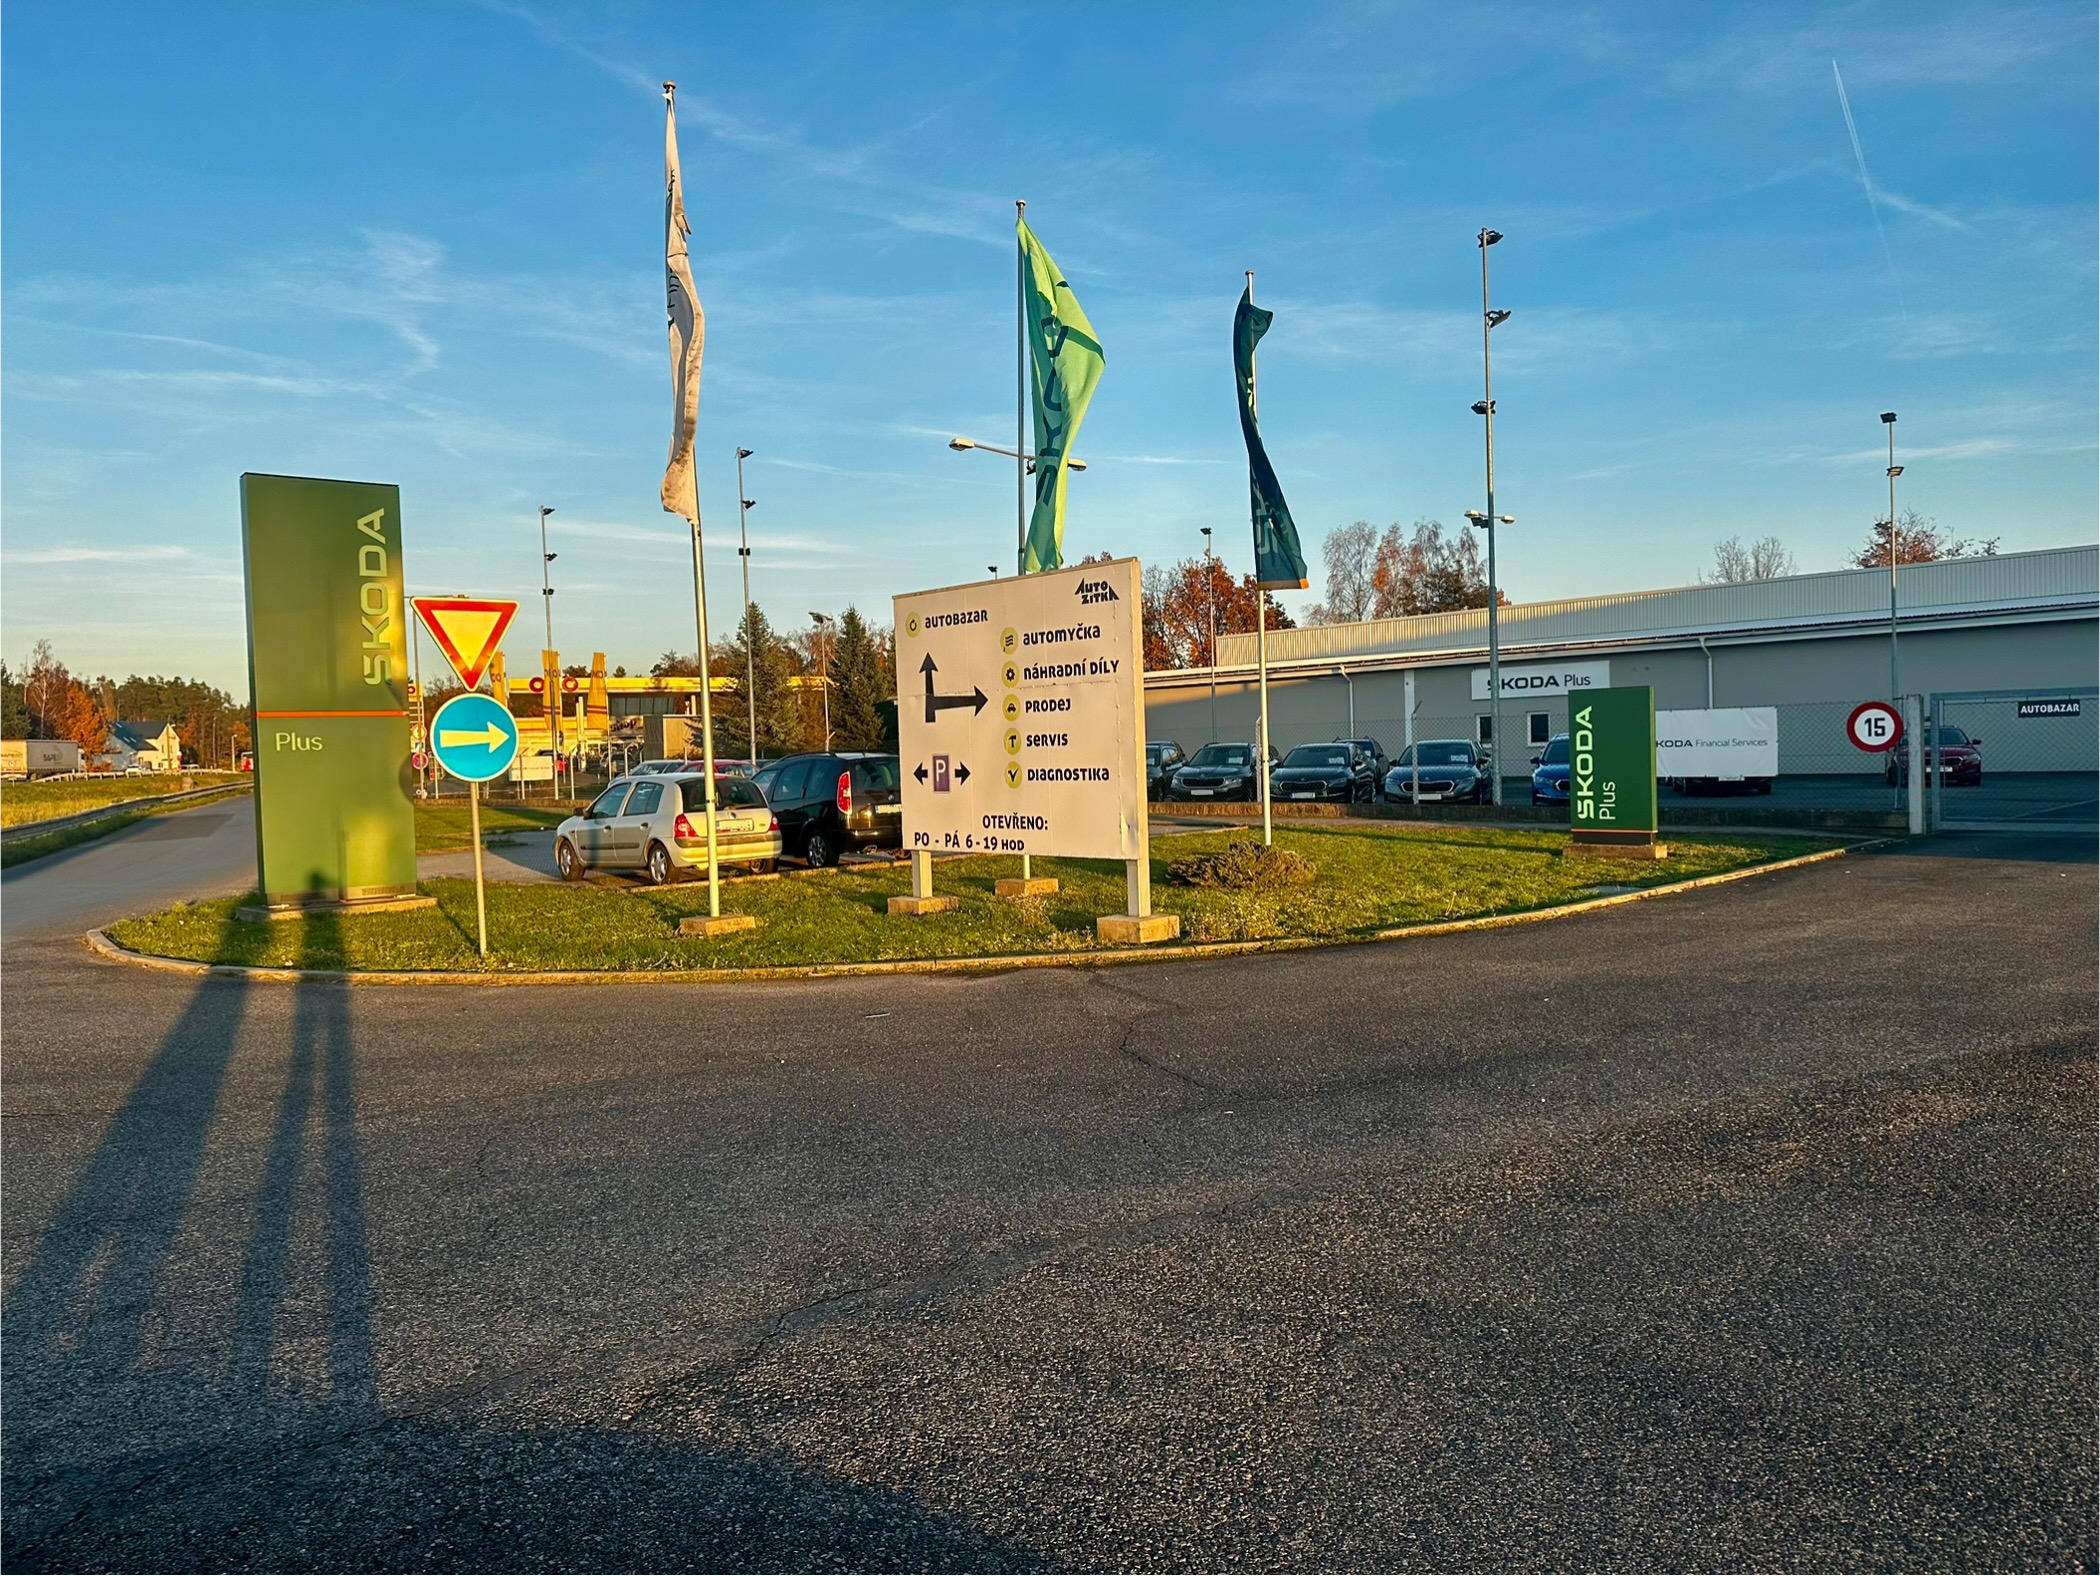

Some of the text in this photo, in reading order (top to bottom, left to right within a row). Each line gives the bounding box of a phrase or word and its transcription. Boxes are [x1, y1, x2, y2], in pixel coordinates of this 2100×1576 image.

[1074, 577, 1109, 595] AUTO
[1564, 674, 1591, 686] Plus
[2020, 702, 2080, 715] AUTOBAZAR
[1864, 717, 1886, 737] 15
[275, 732, 323, 752] Plus
[1655, 738, 1768, 748] KODA Financial Services
[935, 758, 946, 781] P
[1599, 781, 1616, 820] Plus
[982, 812, 1049, 831] OTEVŘENO:
[914, 832, 930, 847] PO
[944, 829, 961, 849] PÁ
[1001, 839, 1025, 851] HOD
